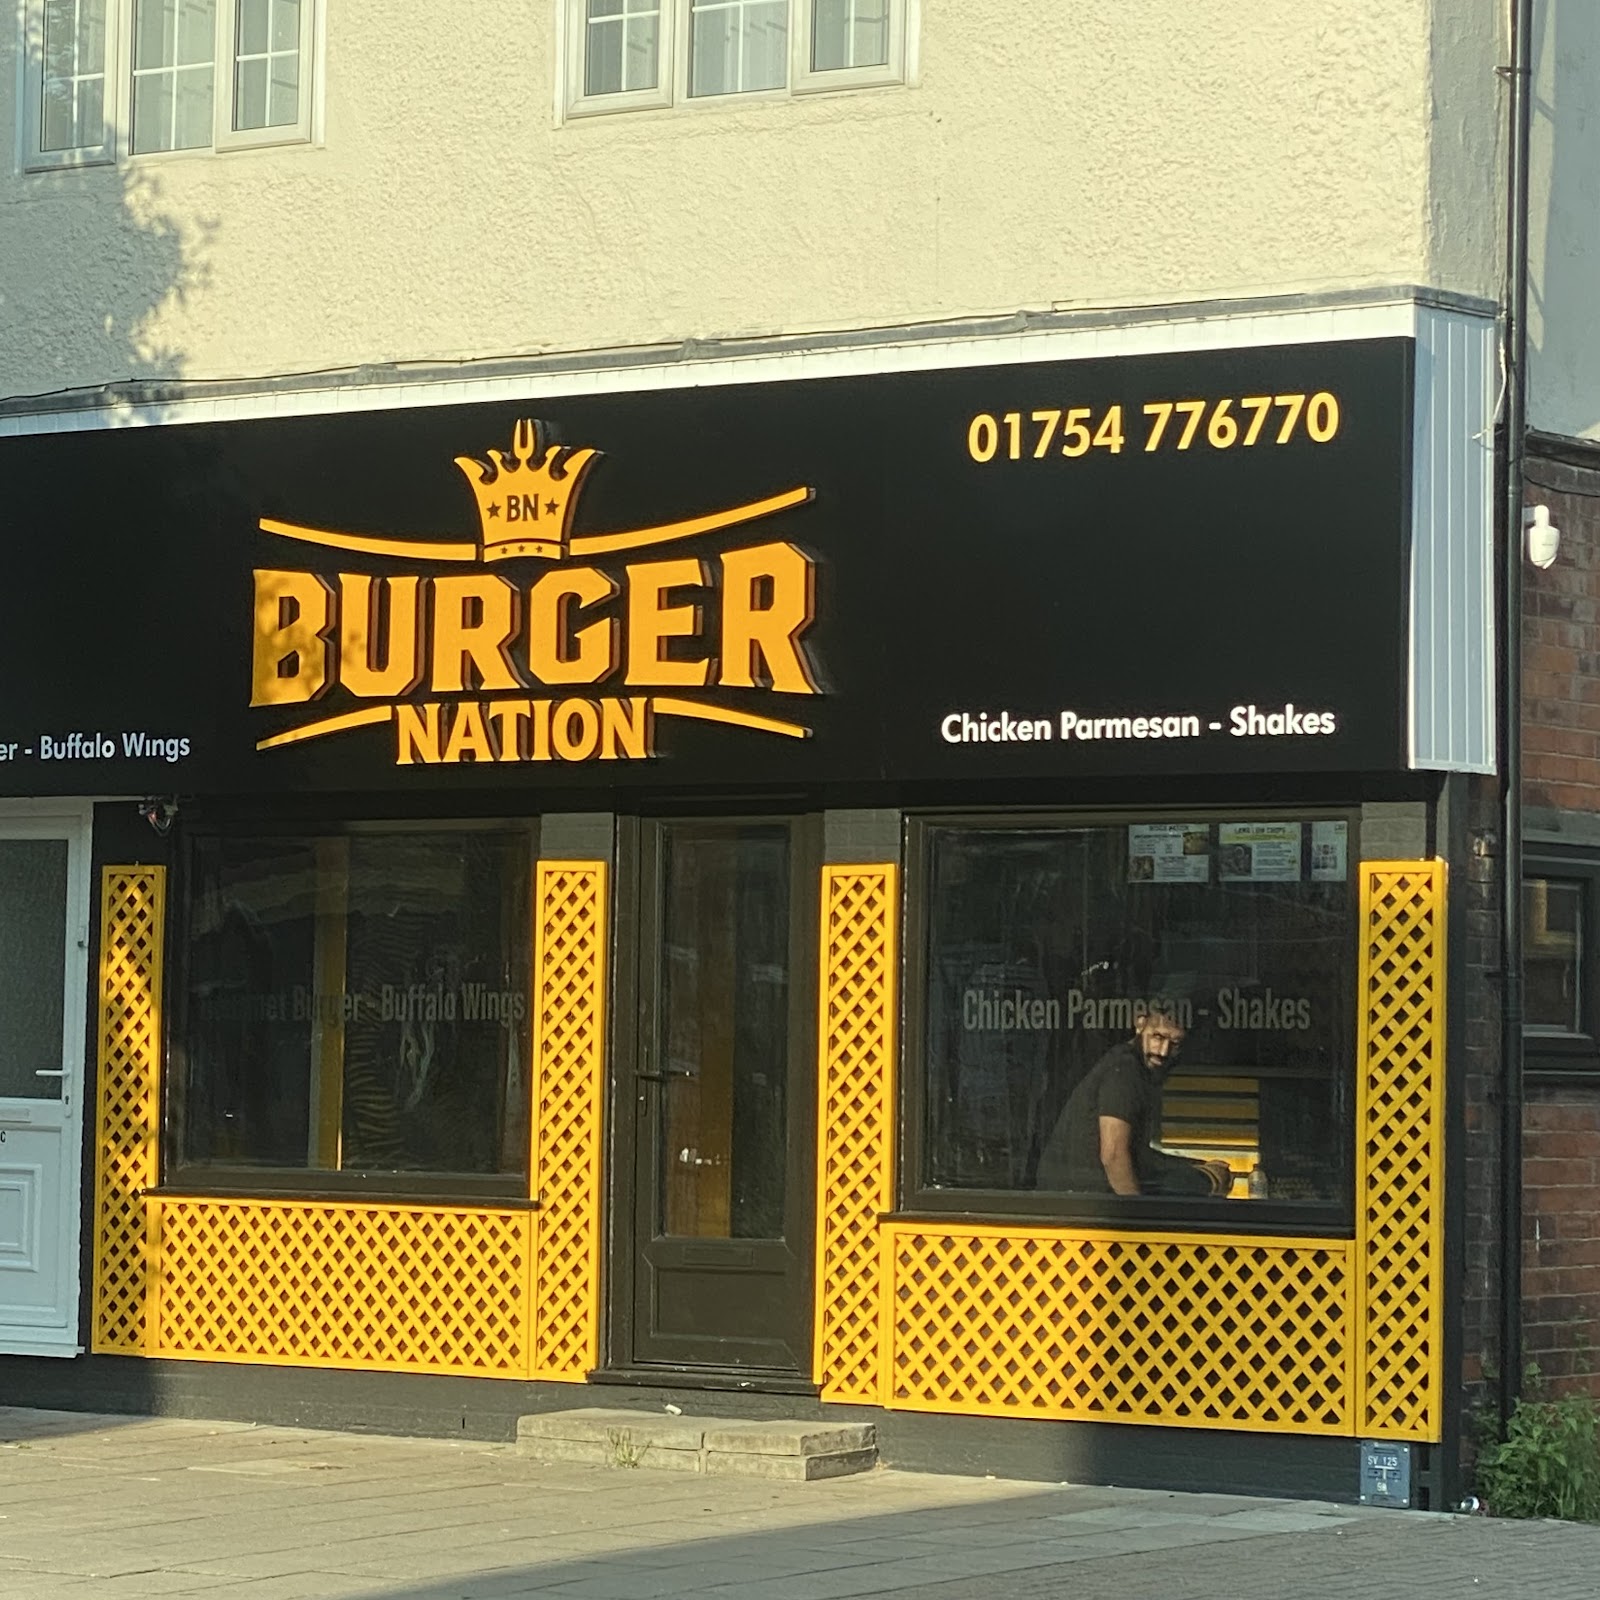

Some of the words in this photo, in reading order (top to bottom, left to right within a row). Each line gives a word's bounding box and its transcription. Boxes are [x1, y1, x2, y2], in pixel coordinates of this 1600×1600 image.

[968, 405, 1125, 463] 01754
[1143, 391, 1340, 452] 776770
[506, 493, 539, 523] BN
[249, 541, 820, 707] BURGER
[396, 697, 652, 765] NATION
[940, 710, 1053, 744] Chicken
[1060, 710, 1200, 741] Parmesan
[1229, 703, 1336, 737] Shakes
[40, 732, 116, 760] Buffalo
[122, 732, 190, 763] Wings
[381, 983, 456, 1022] Buffalo
[462, 982, 525, 1028] Wings
[963, 988, 1060, 1031] Chicken
[1217, 987, 1311, 1030] Shakes
